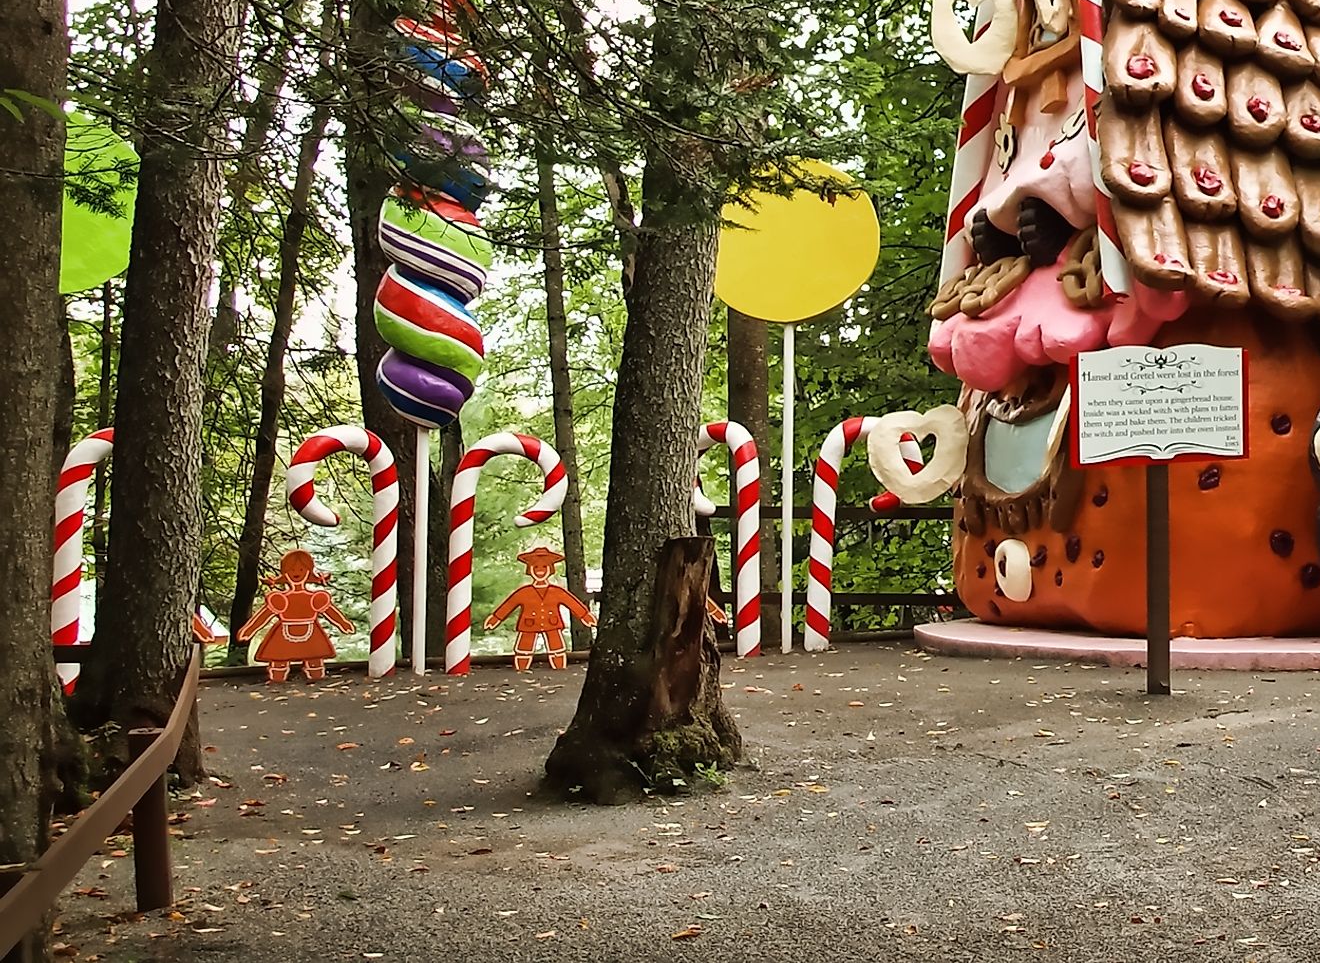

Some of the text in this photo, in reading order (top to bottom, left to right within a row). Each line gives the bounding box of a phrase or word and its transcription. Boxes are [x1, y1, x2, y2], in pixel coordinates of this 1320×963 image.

[1082, 372, 1111, 382] Hansel
[1171, 395, 1211, 404] gingerbread
[1192, 406, 1209, 414] plans
[1130, 428, 1154, 437] pushed
